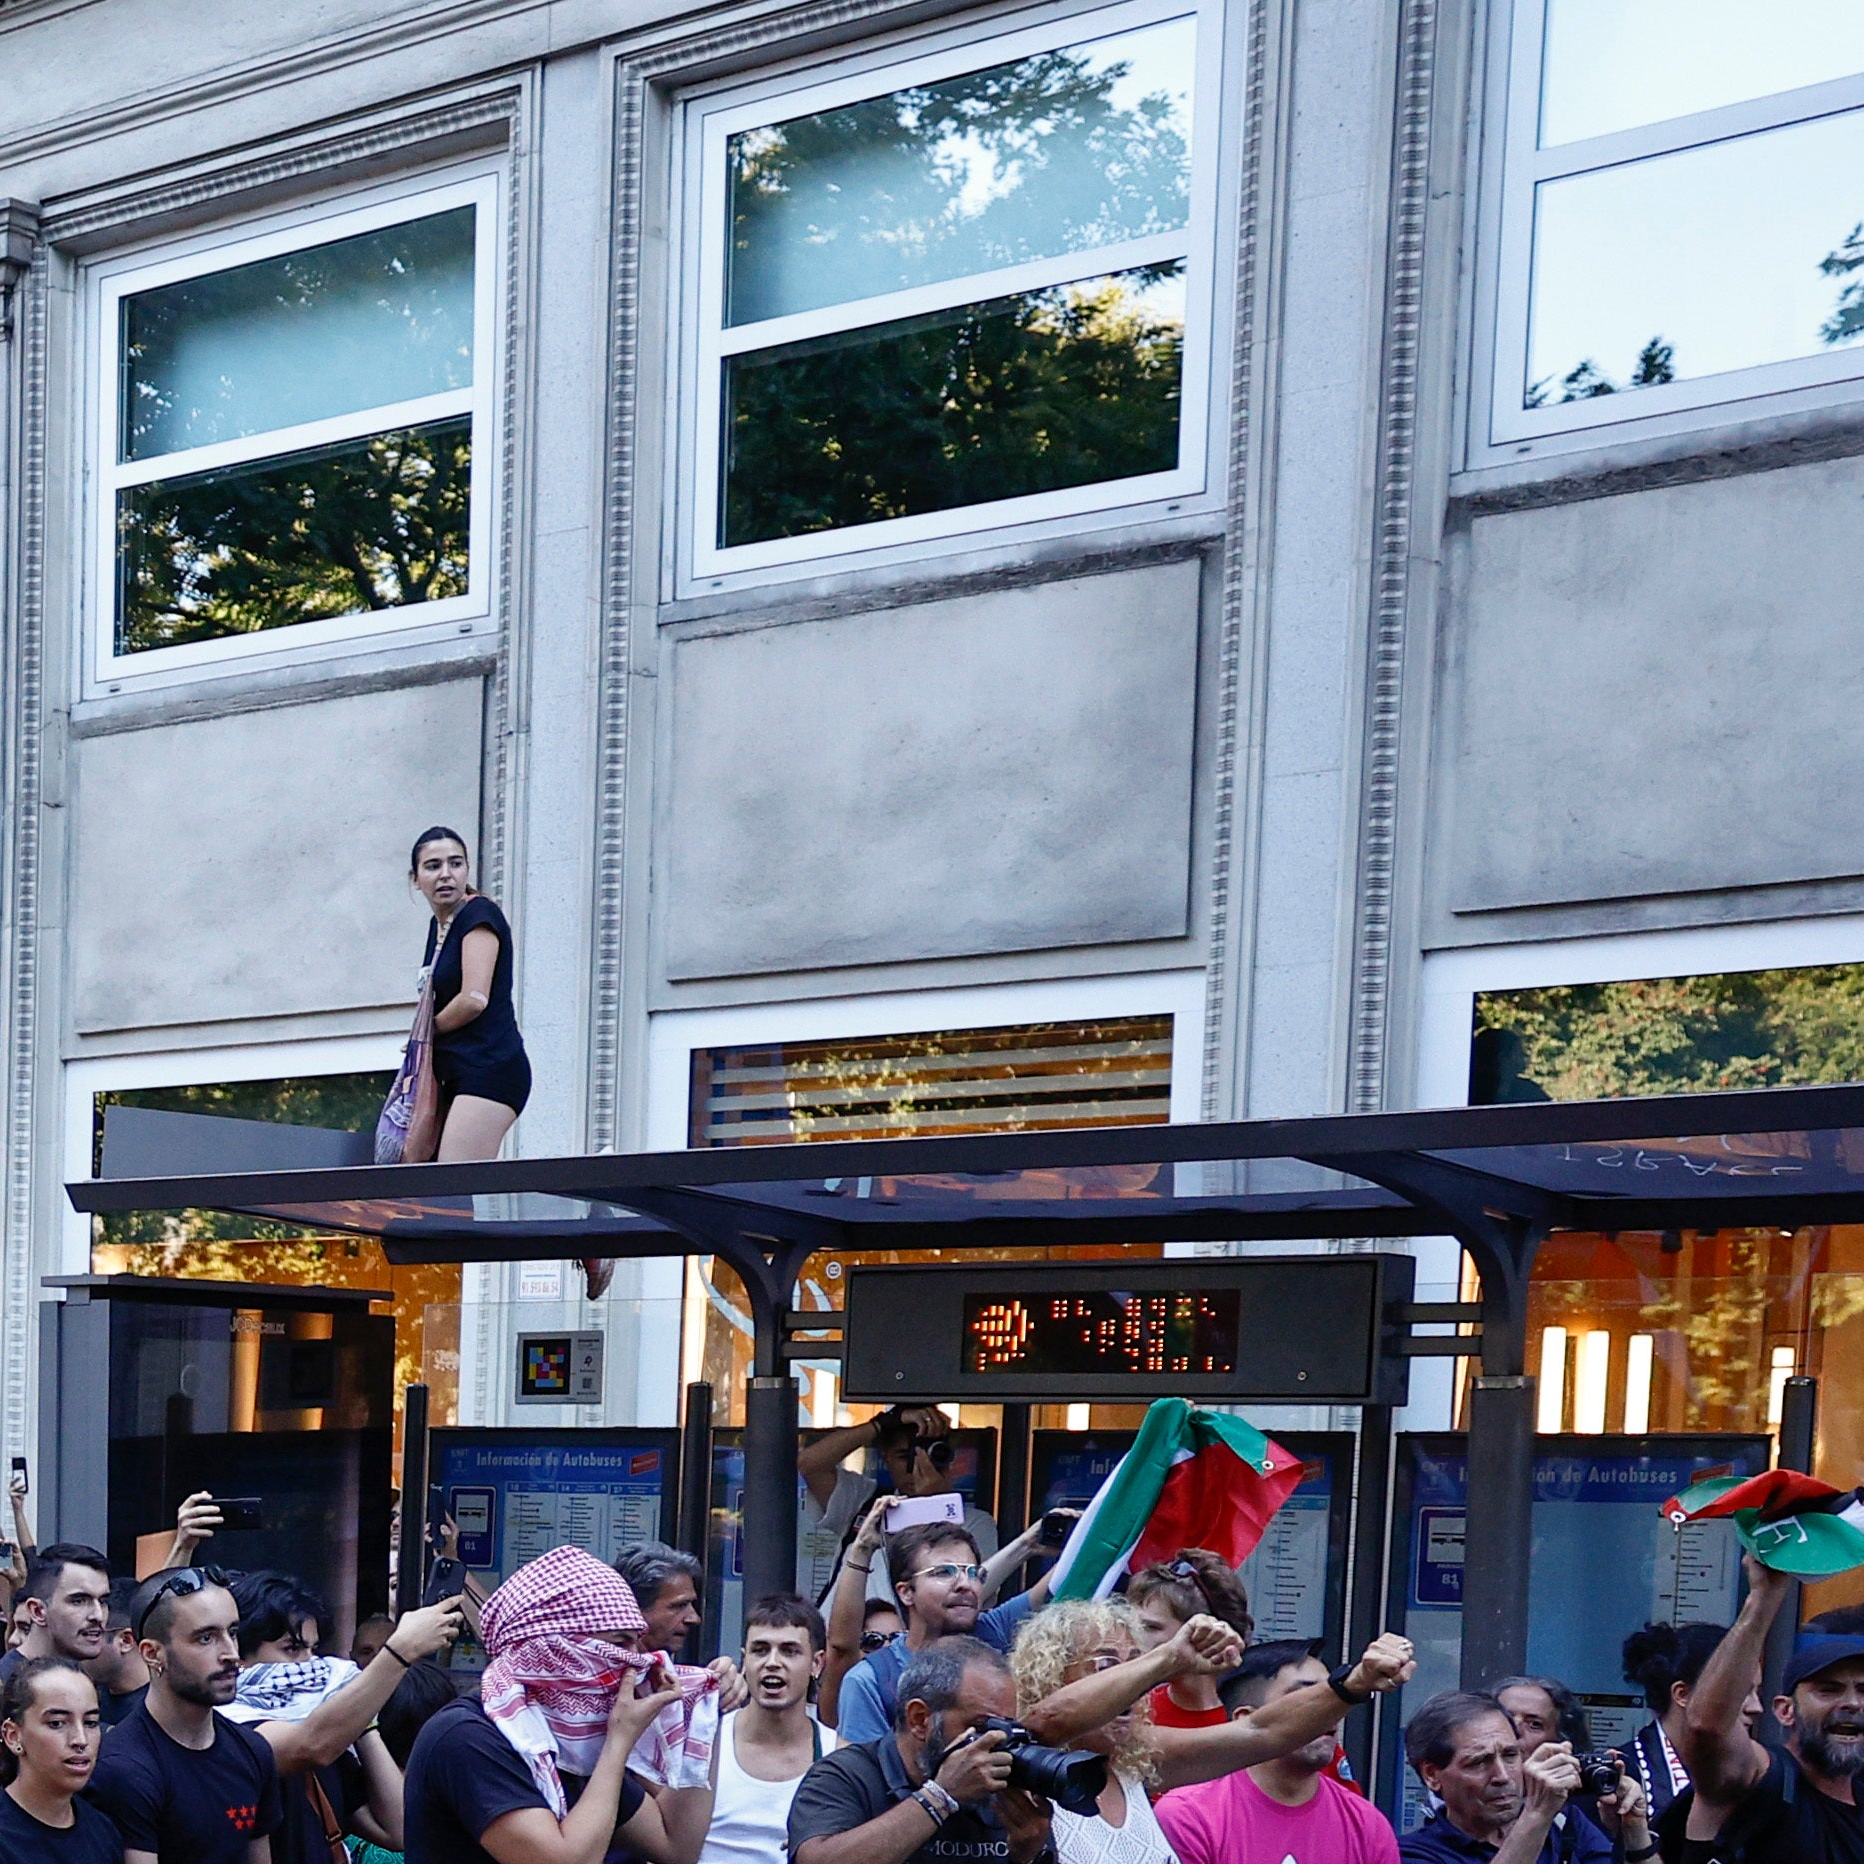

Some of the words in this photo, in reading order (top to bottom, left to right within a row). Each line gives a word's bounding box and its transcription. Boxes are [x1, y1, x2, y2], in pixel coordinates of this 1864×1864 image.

[476, 1451, 541, 1467] Información
[544, 1451, 559, 1467] de
[563, 1452, 622, 1468] Autobuses
[1561, 1464, 1582, 1484] de
[1587, 1465, 1678, 1484] Autobuses
